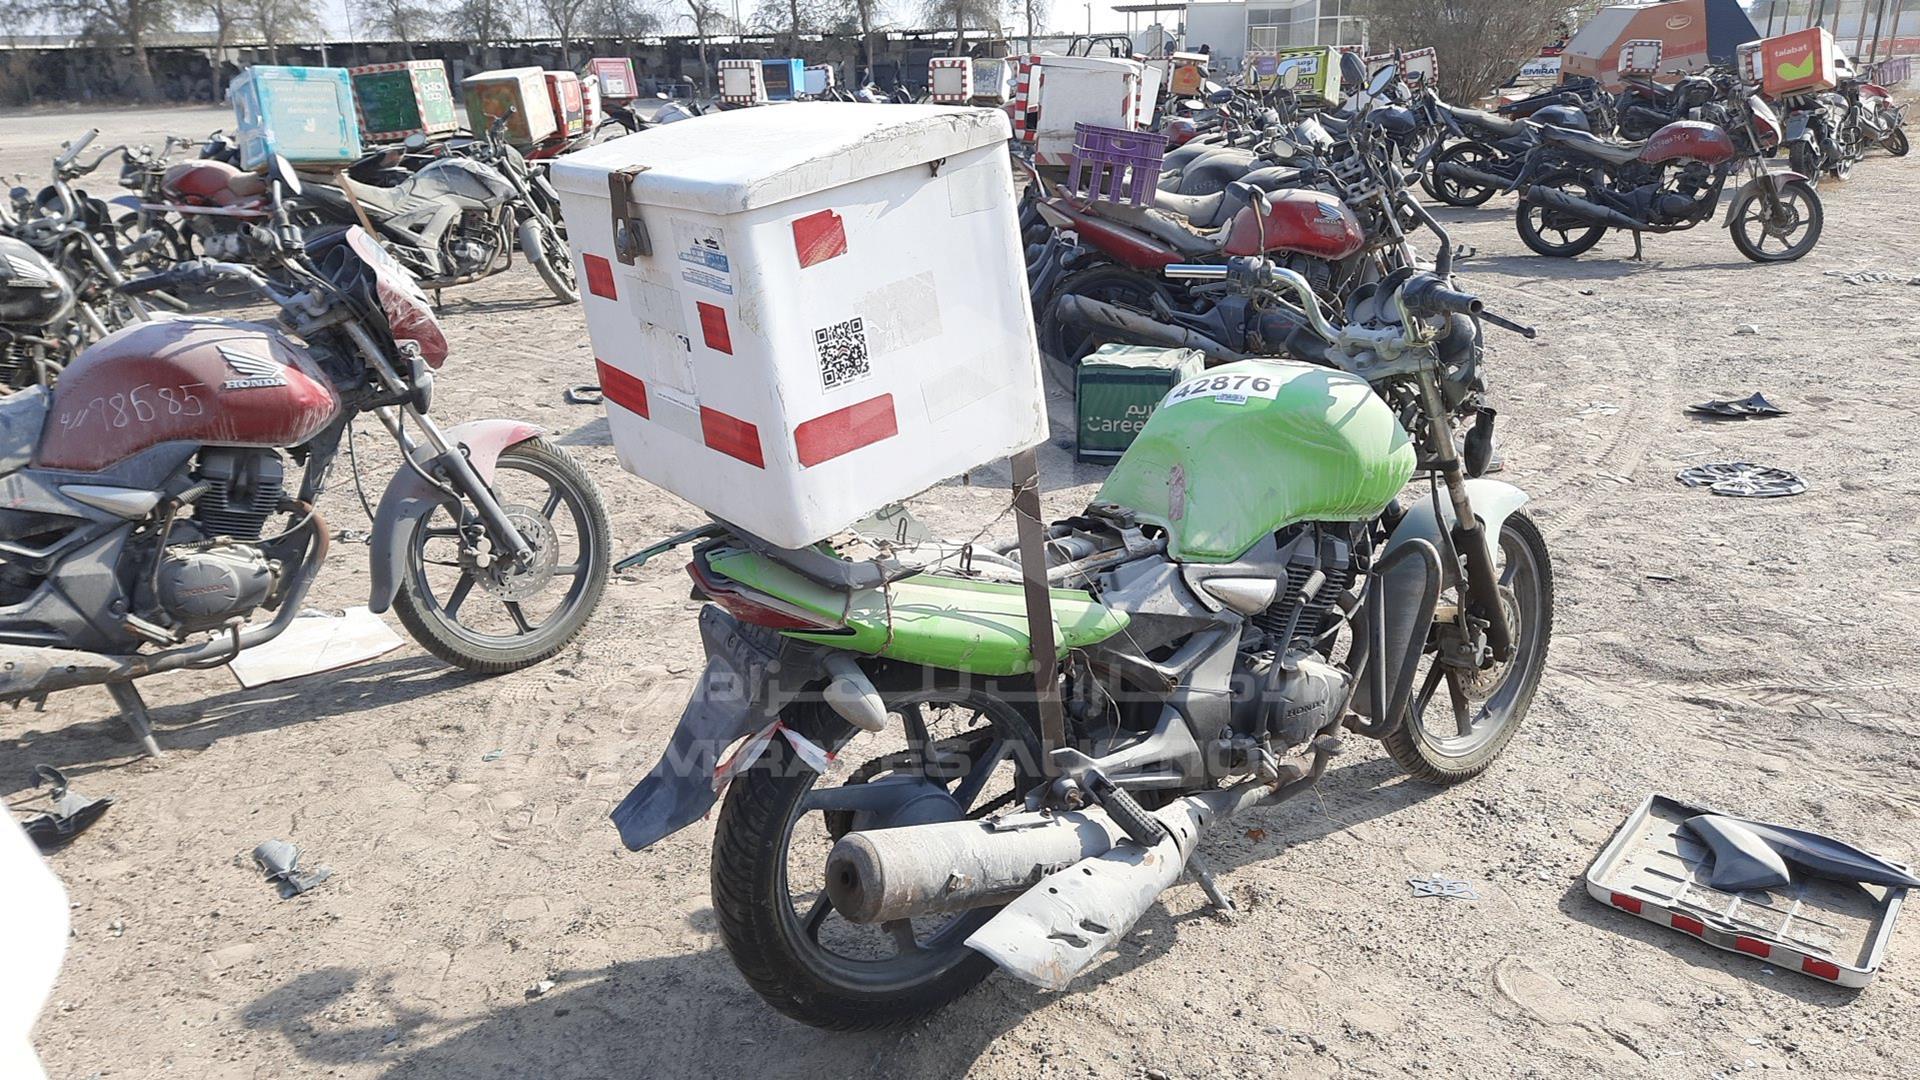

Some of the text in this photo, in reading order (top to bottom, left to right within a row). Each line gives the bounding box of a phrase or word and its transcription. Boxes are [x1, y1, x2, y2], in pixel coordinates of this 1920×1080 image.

[1774, 44, 1807, 57] talabat
[224, 378, 288, 389] HONDA
[1173, 375, 1272, 398] 42876
[1287, 700, 1326, 718] HONDA
